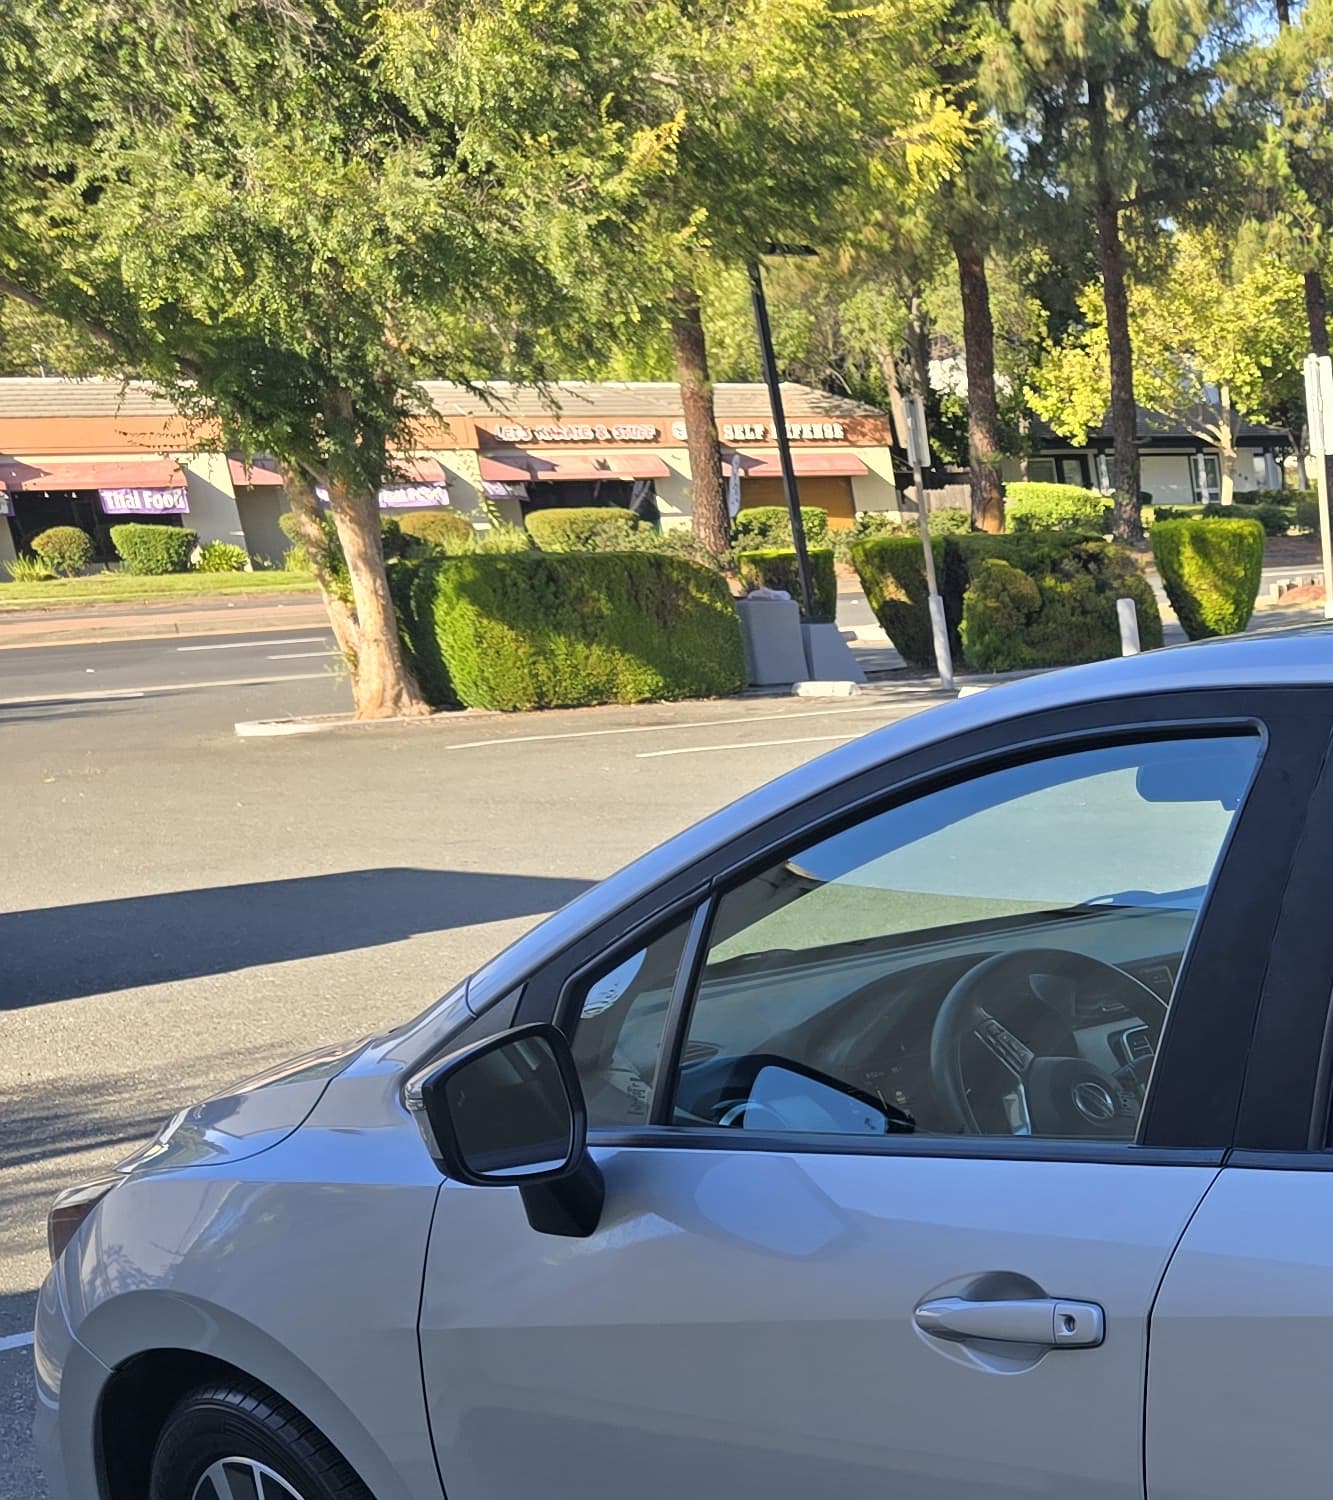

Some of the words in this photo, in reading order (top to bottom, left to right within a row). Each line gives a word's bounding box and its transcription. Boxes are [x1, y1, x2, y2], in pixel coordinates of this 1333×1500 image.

[612, 424, 656, 441] STUFF
[723, 423, 766, 440] SELF
[101, 488, 141, 510] Thai
[142, 488, 186, 509] Food
